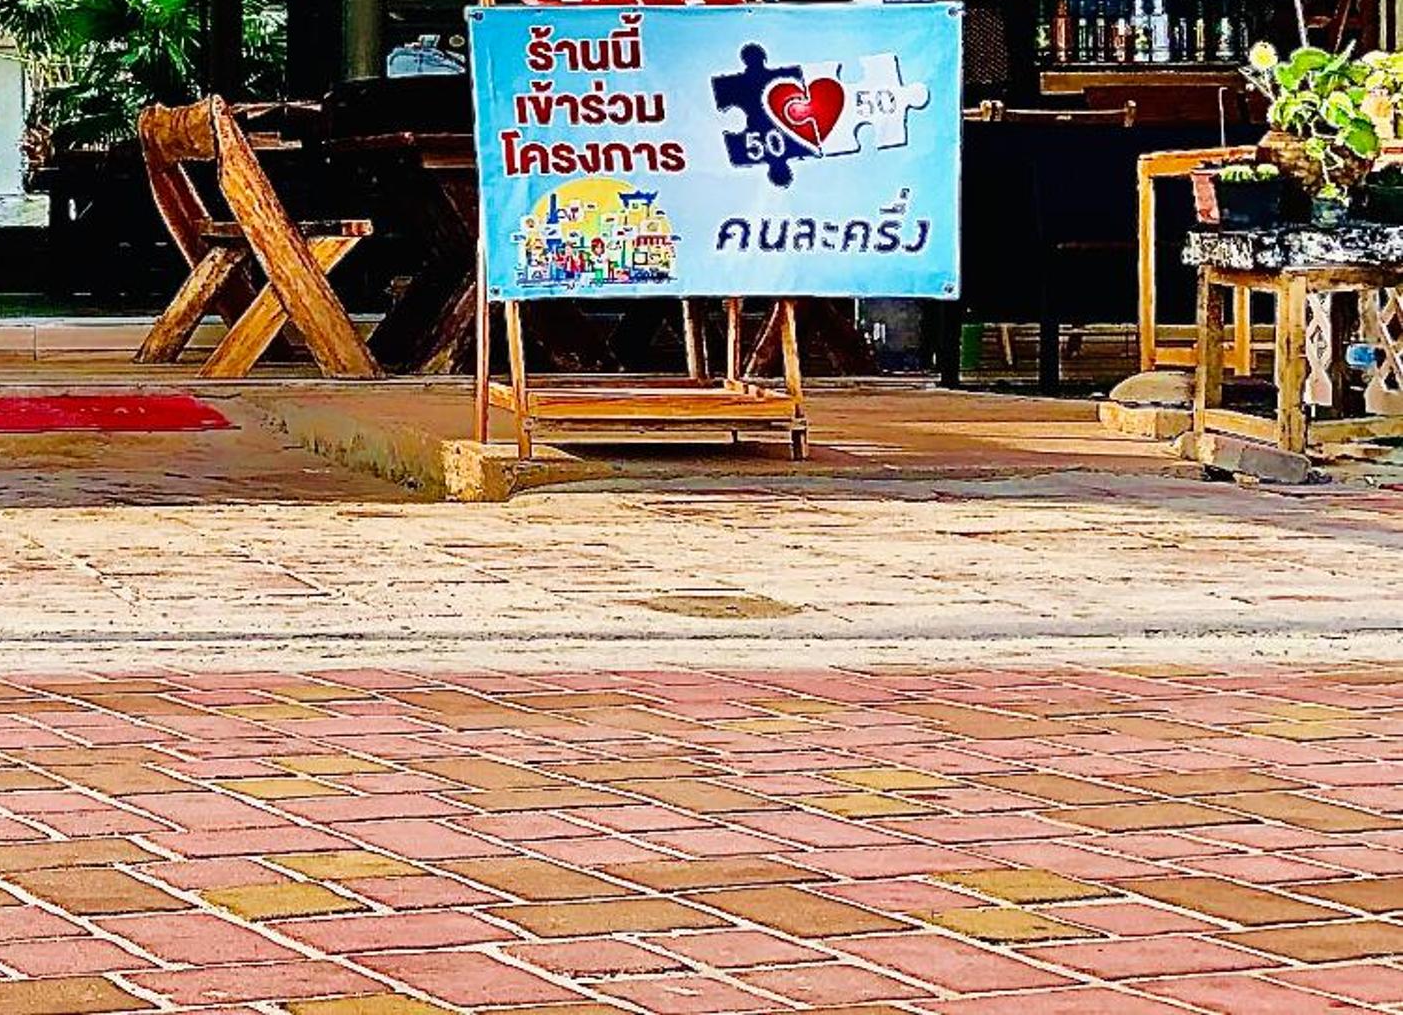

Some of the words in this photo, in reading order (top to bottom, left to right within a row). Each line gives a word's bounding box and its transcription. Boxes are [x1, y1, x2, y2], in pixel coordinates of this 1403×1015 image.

[527, 13, 643, 72] ร้านนี้
[515, 80, 666, 125] เข้าร่วม
[855, 88, 898, 118] 50
[500, 130, 687, 176] โครงการ
[745, 132, 786, 161] 50
